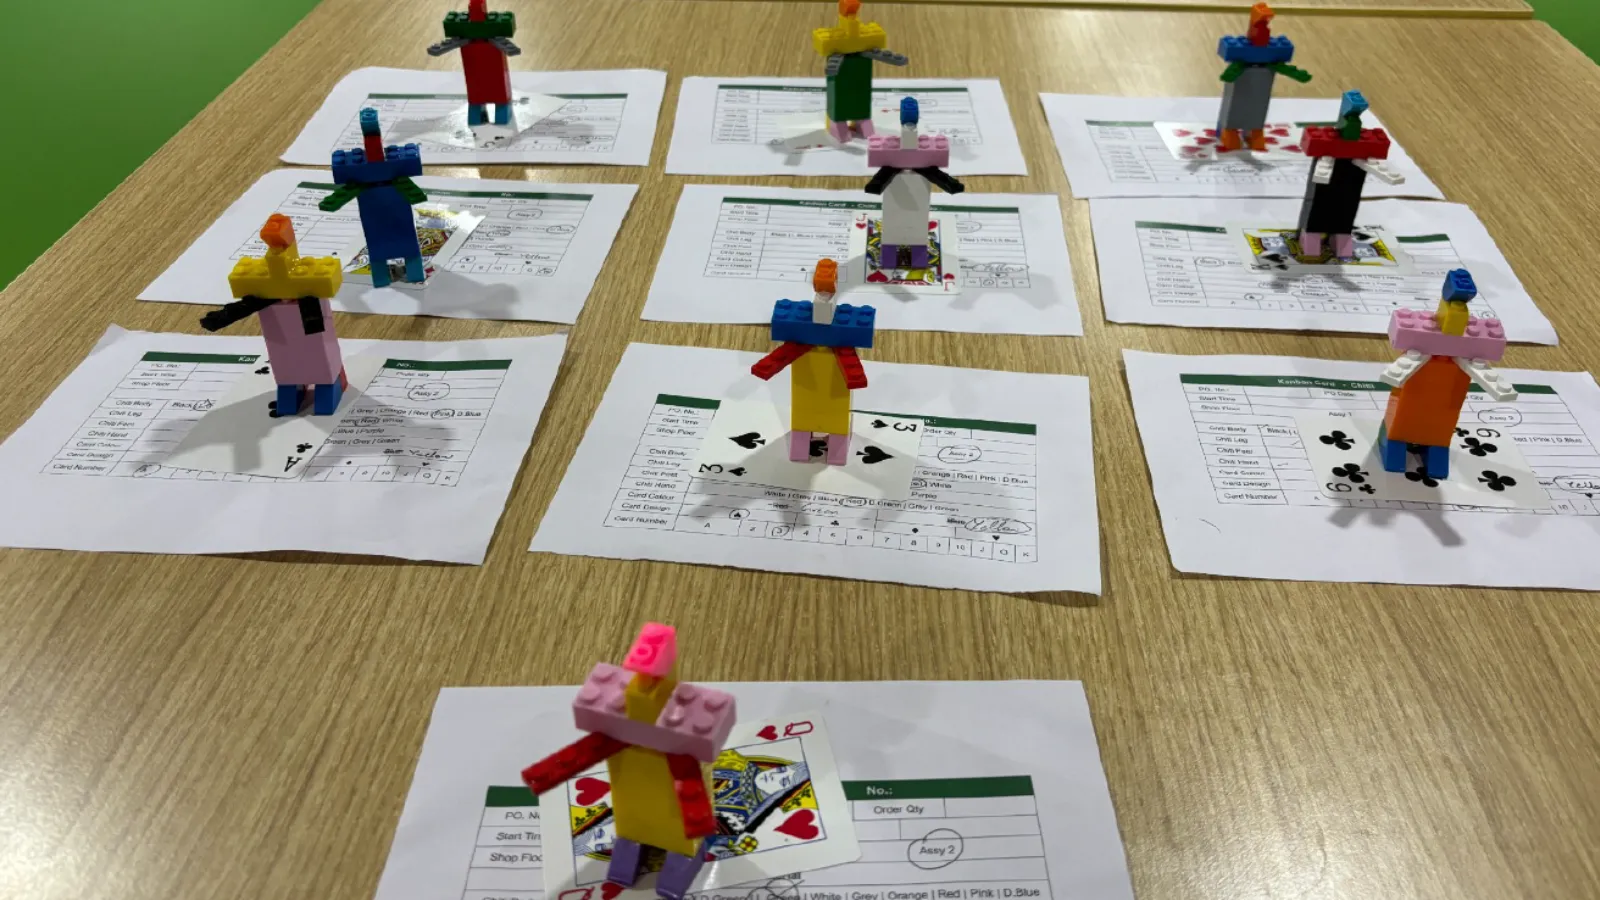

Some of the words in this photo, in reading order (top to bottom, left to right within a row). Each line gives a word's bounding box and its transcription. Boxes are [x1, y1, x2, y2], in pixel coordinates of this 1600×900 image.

[1277, 378, 1313, 386] Kanban
[893, 422, 917, 433] 3
[1476, 427, 1501, 439] 6
[284, 456, 303, 472] A
[698, 463, 723, 474] 3
[956, 472, 973, 480] Red
[980, 474, 996, 482] Pink
[1326, 482, 1352, 493] 6
[622, 502, 641, 510] Card
[643, 504, 672, 512] Design
[783, 720, 814, 737] Q
[866, 785, 893, 796] No.:
[873, 805, 903, 815] Order
[906, 804, 924, 815] Qty
[504, 812, 524, 821] PO.
[496, 832, 520, 842] Start
[919, 846, 946, 856] Assy
[948, 845, 956, 854] 2
[490, 852, 519, 863] Shop
[888, 889, 928, 900] Orange
[937, 888, 960, 898] Red
[970, 888, 995, 898] Pink
[1004, 887, 1041, 897] D.Blue
